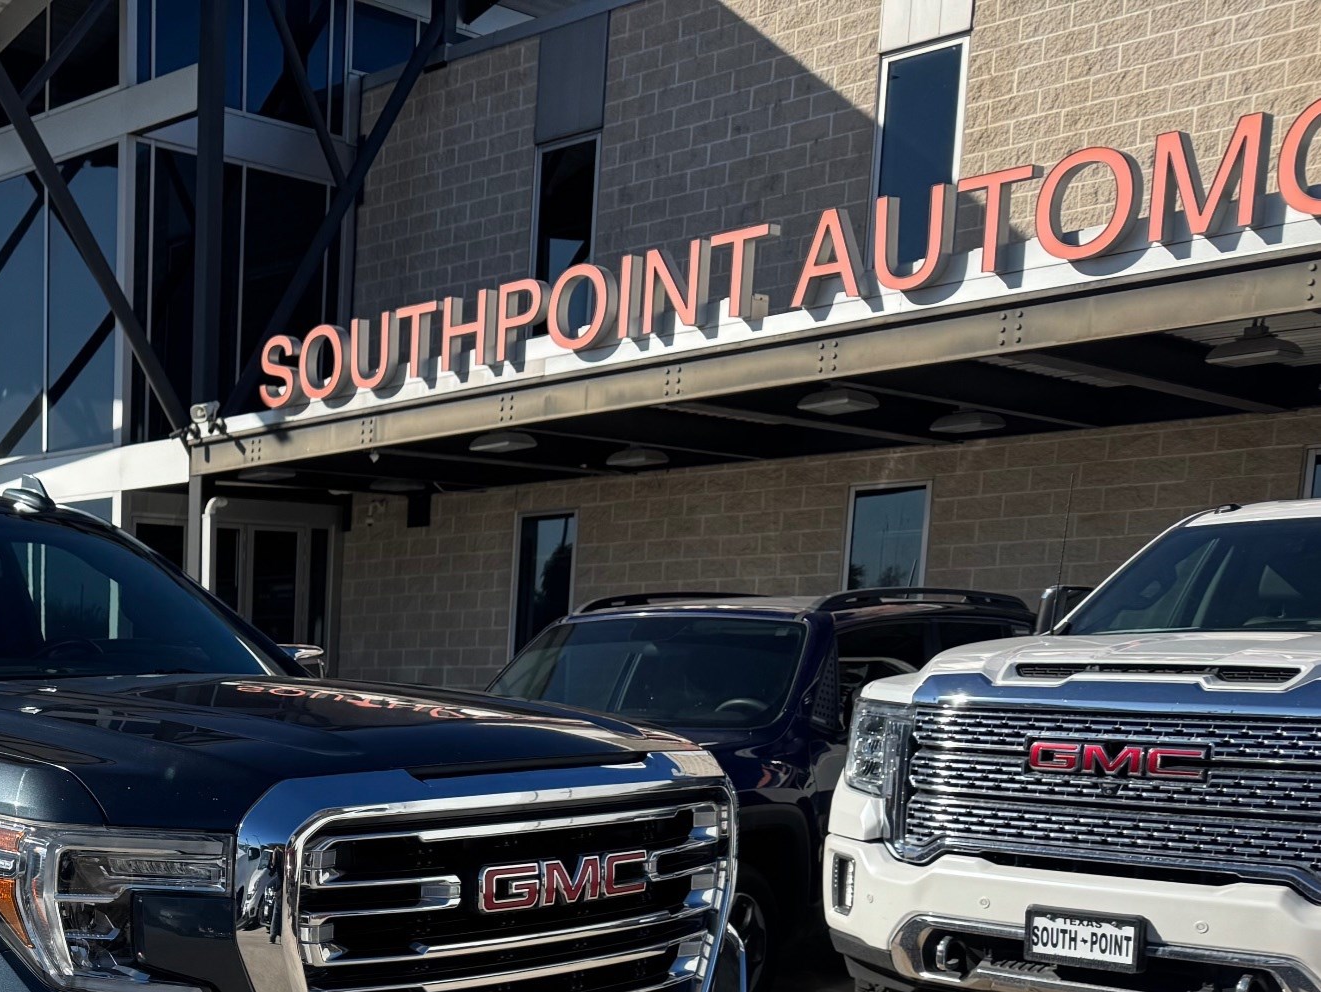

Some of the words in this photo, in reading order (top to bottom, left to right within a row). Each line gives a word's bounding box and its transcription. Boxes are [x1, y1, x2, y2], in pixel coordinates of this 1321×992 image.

[258, 223, 781, 409] SOUTHPOINT
[1030, 742, 1204, 779] GMC
[479, 850, 647, 913] GMC
[1032, 925, 1078, 951] SOUTH
[1089, 931, 1132, 957] POINT
